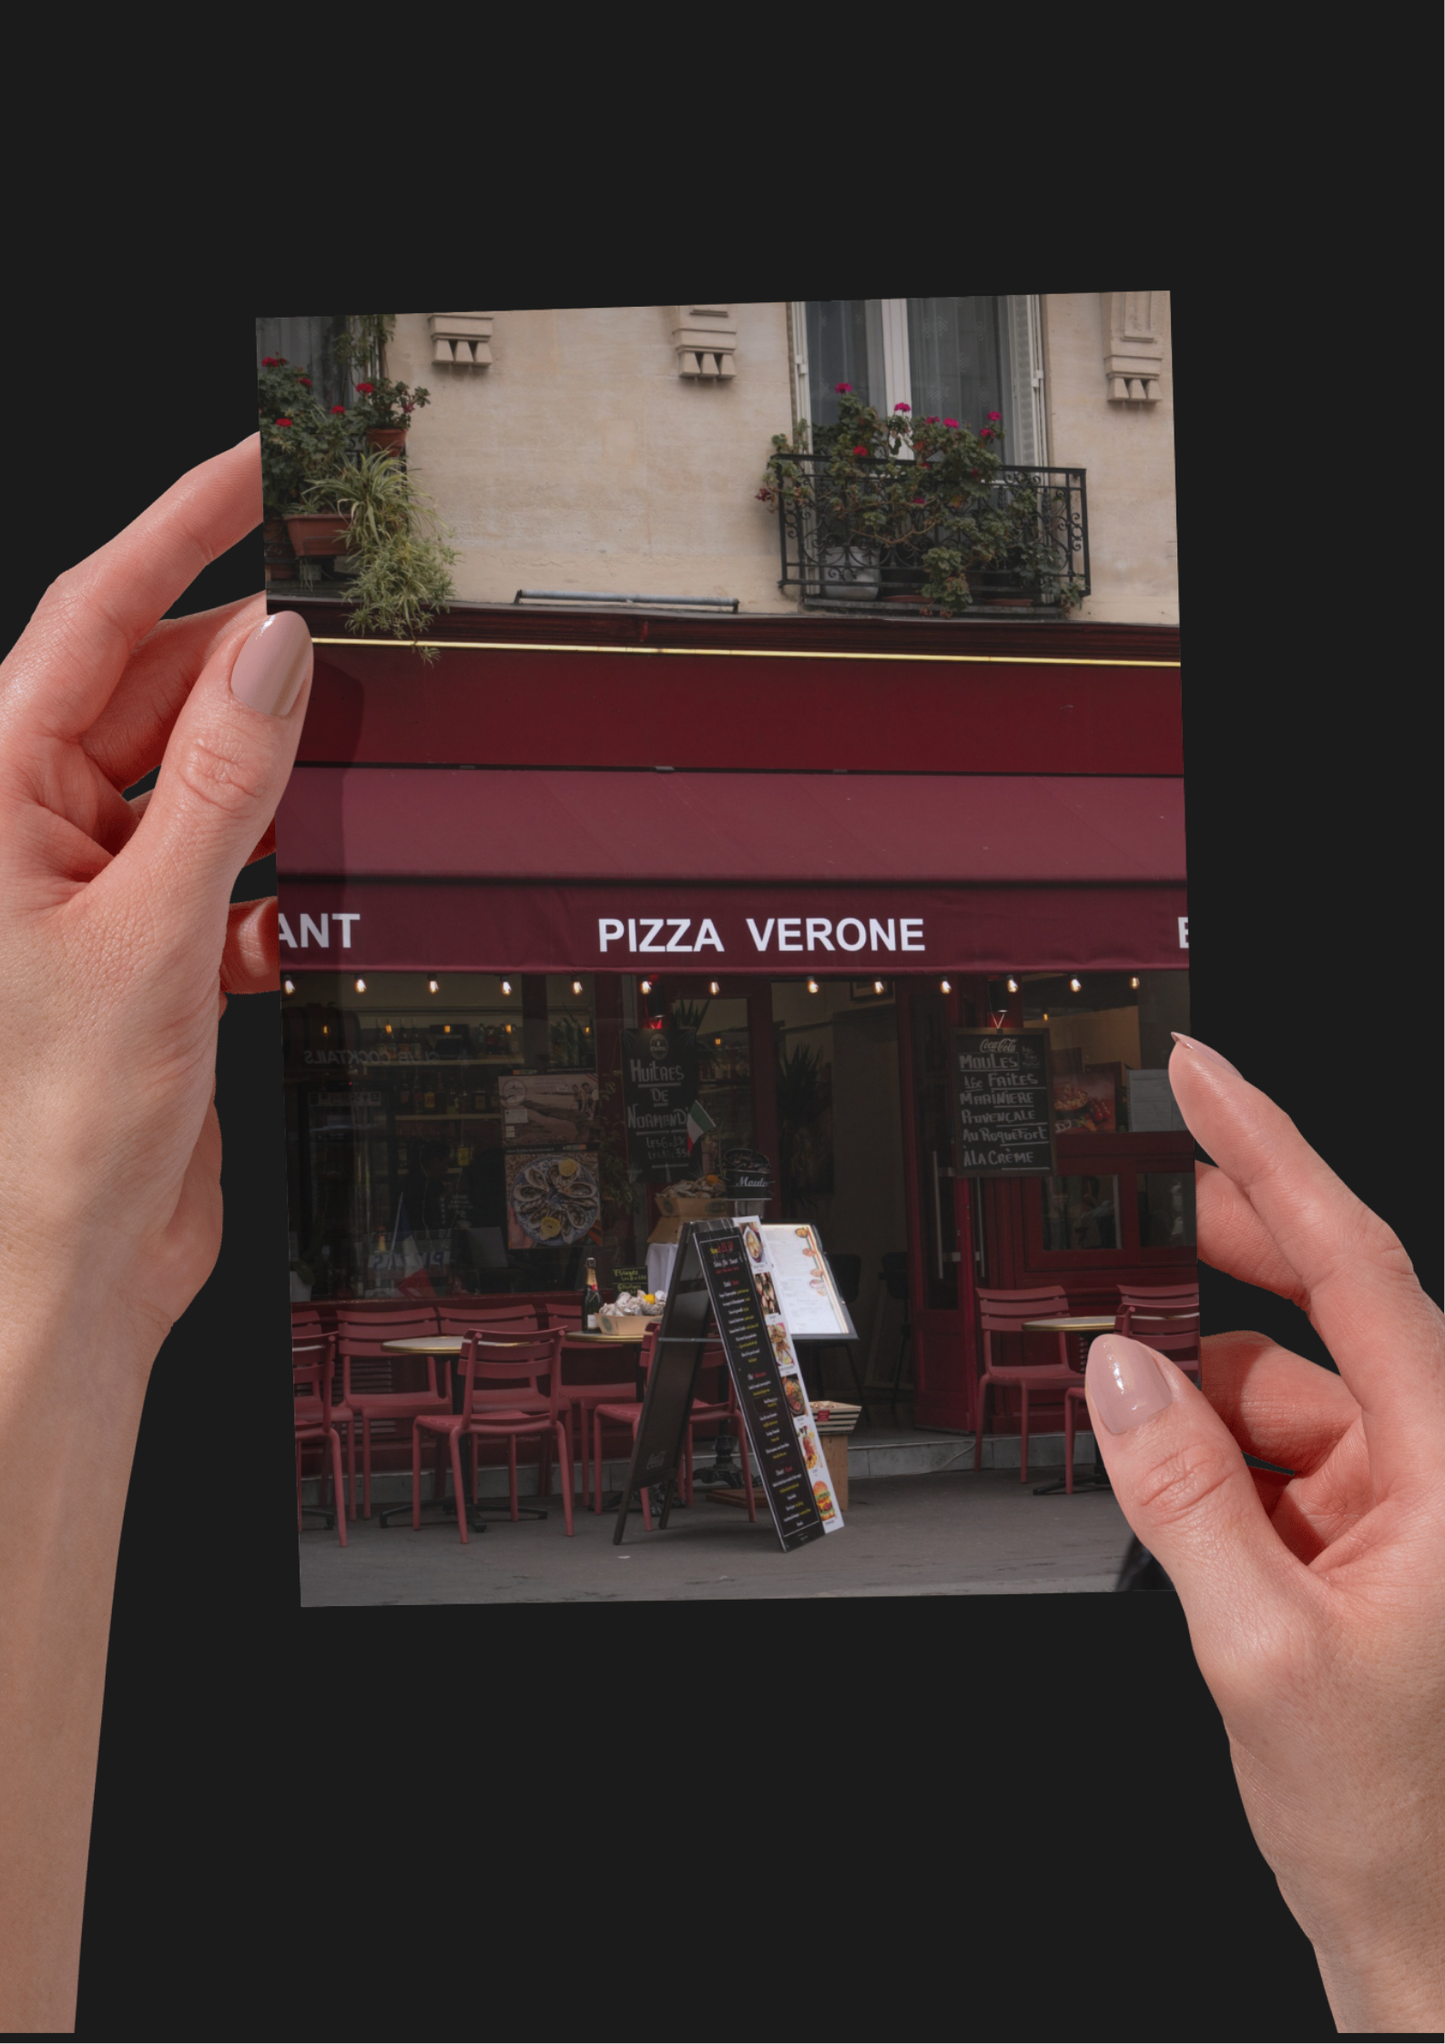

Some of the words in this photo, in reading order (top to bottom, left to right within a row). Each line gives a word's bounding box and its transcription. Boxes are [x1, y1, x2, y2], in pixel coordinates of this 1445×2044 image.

[278, 913, 361, 948] ANT
[598, 918, 725, 953] PIZZA
[745, 917, 926, 952] VERONE
[650, 1088, 669, 1102] DE
[627, 1103, 689, 1129] NORMAND
